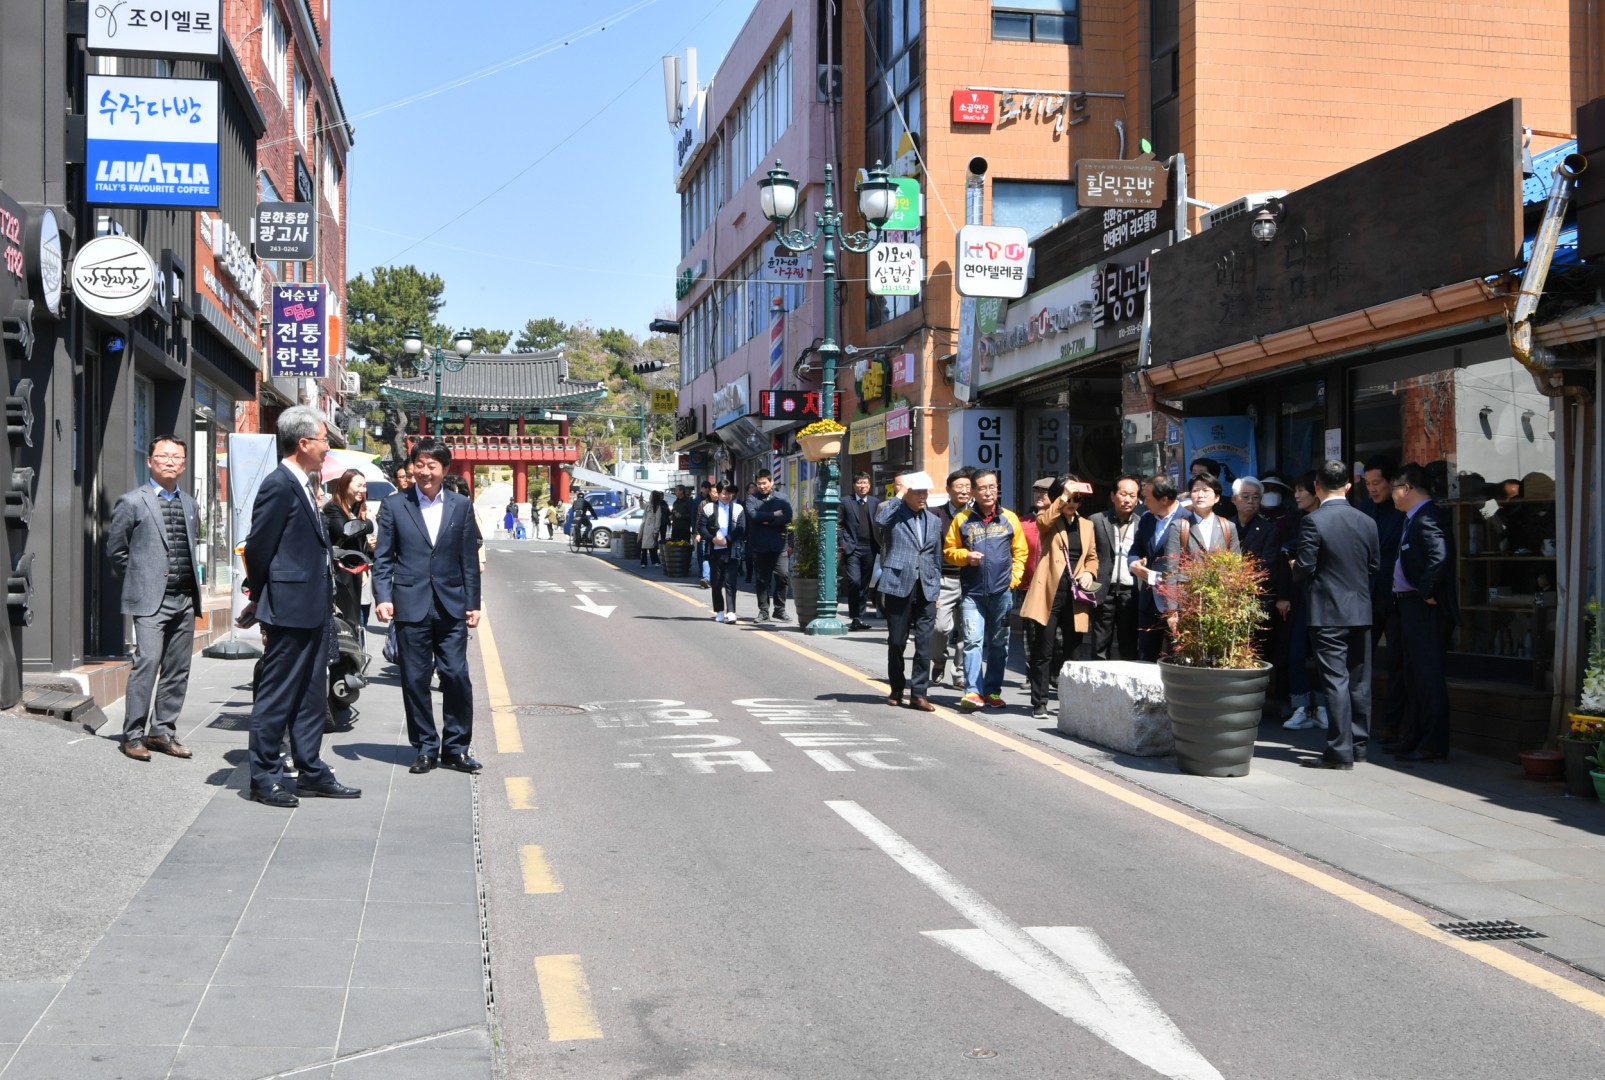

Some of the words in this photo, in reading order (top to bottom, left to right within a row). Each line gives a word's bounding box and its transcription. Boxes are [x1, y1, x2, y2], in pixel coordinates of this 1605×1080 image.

[127, 8, 213, 33] 조이엘로
[99, 89, 202, 126] 수작다방
[95, 153, 210, 185] LAVAZZA
[95, 183, 127, 192] ITALY'S
[128, 184, 175, 194] FAVOURITE
[177, 186, 210, 195] COFFEE
[1086, 170, 1155, 197] 힐링공방
[259, 211, 310, 225] 문화종합
[259, 225, 310, 243] 광고사
[1103, 222, 1128, 252] 인테리어
[1129, 209, 1157, 238] 리모델링
[877, 246, 913, 263] 이모네
[874, 264, 916, 285] 삼겹살
[963, 263, 1024, 281] 연아텔레콤
[279, 289, 320, 302] 여순남
[276, 322, 322, 343] 전통
[276, 347, 322, 368] 한복
[978, 416, 1003, 475] 연아
